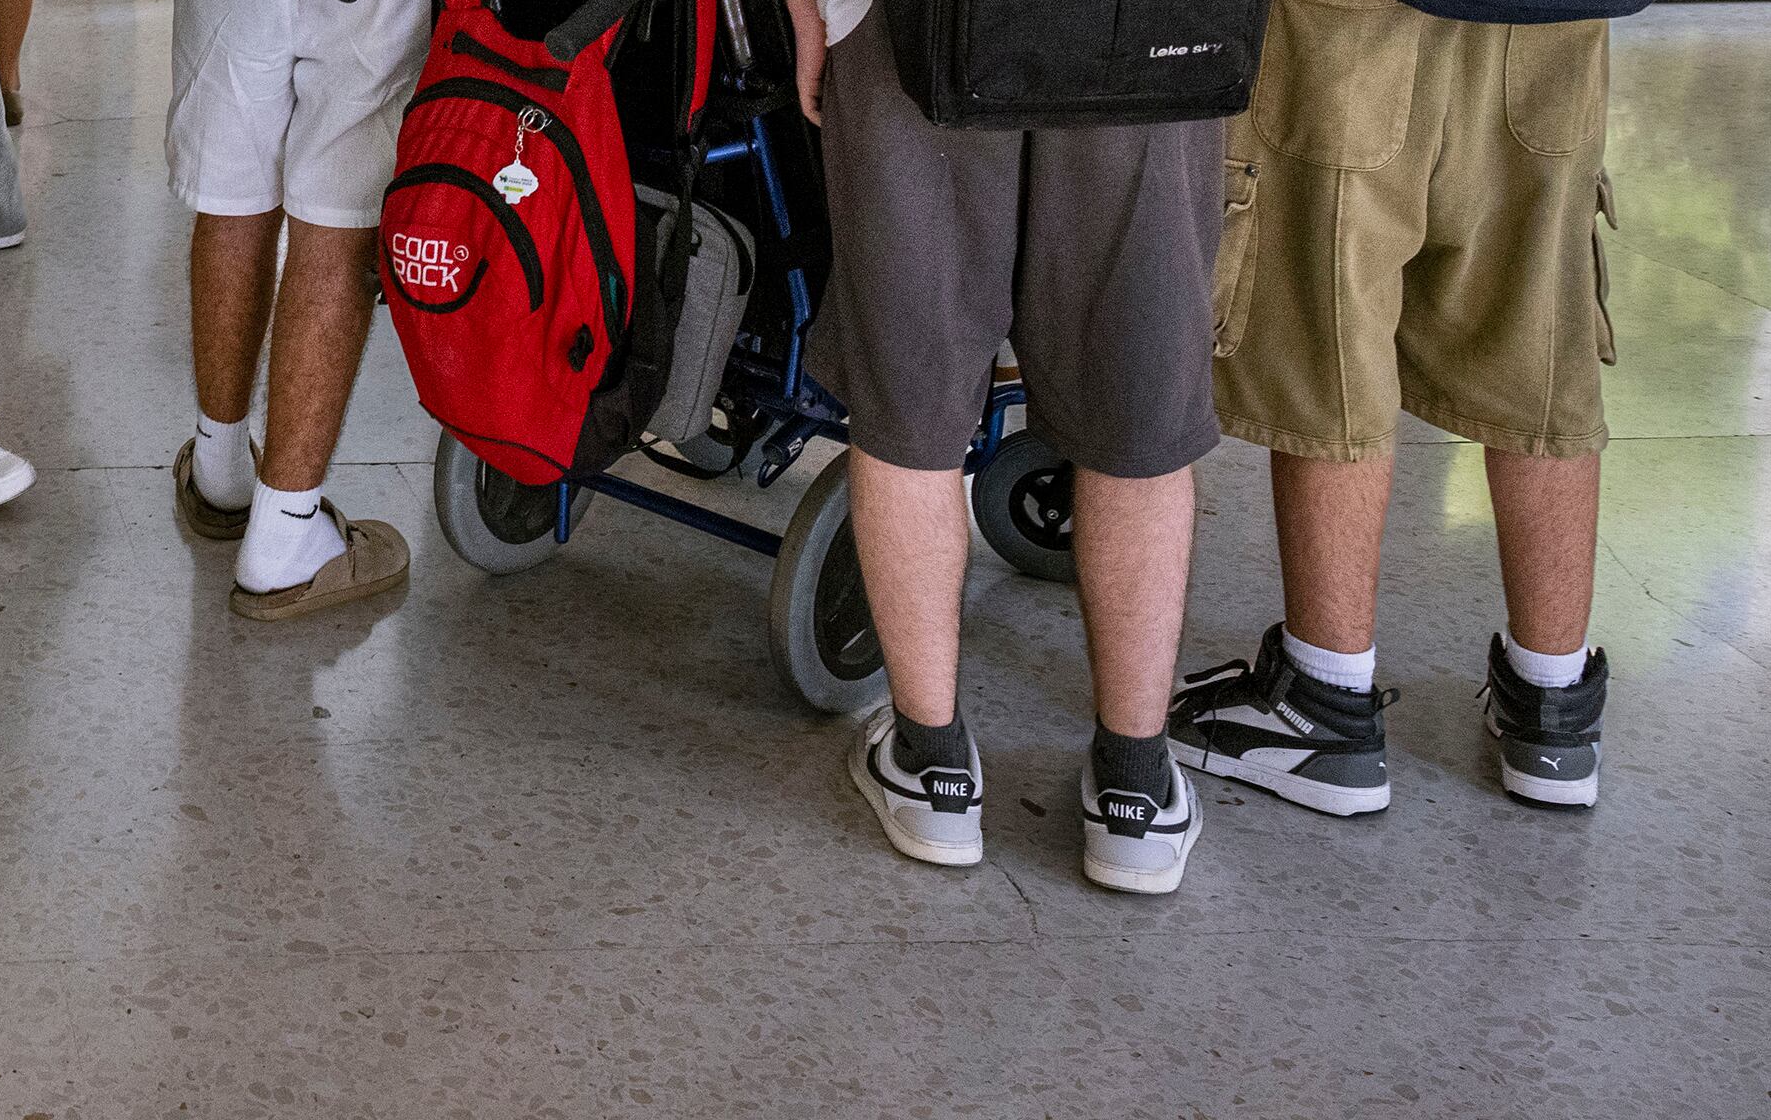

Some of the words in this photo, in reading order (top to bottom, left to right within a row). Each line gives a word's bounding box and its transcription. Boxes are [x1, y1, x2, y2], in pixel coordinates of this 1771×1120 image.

[392, 233, 454, 264] COOL
[392, 256, 461, 292] ROCK
[1276, 701, 1315, 735] PUMA
[933, 780, 968, 797] NIKE
[1108, 801, 1145, 821] NIKE
